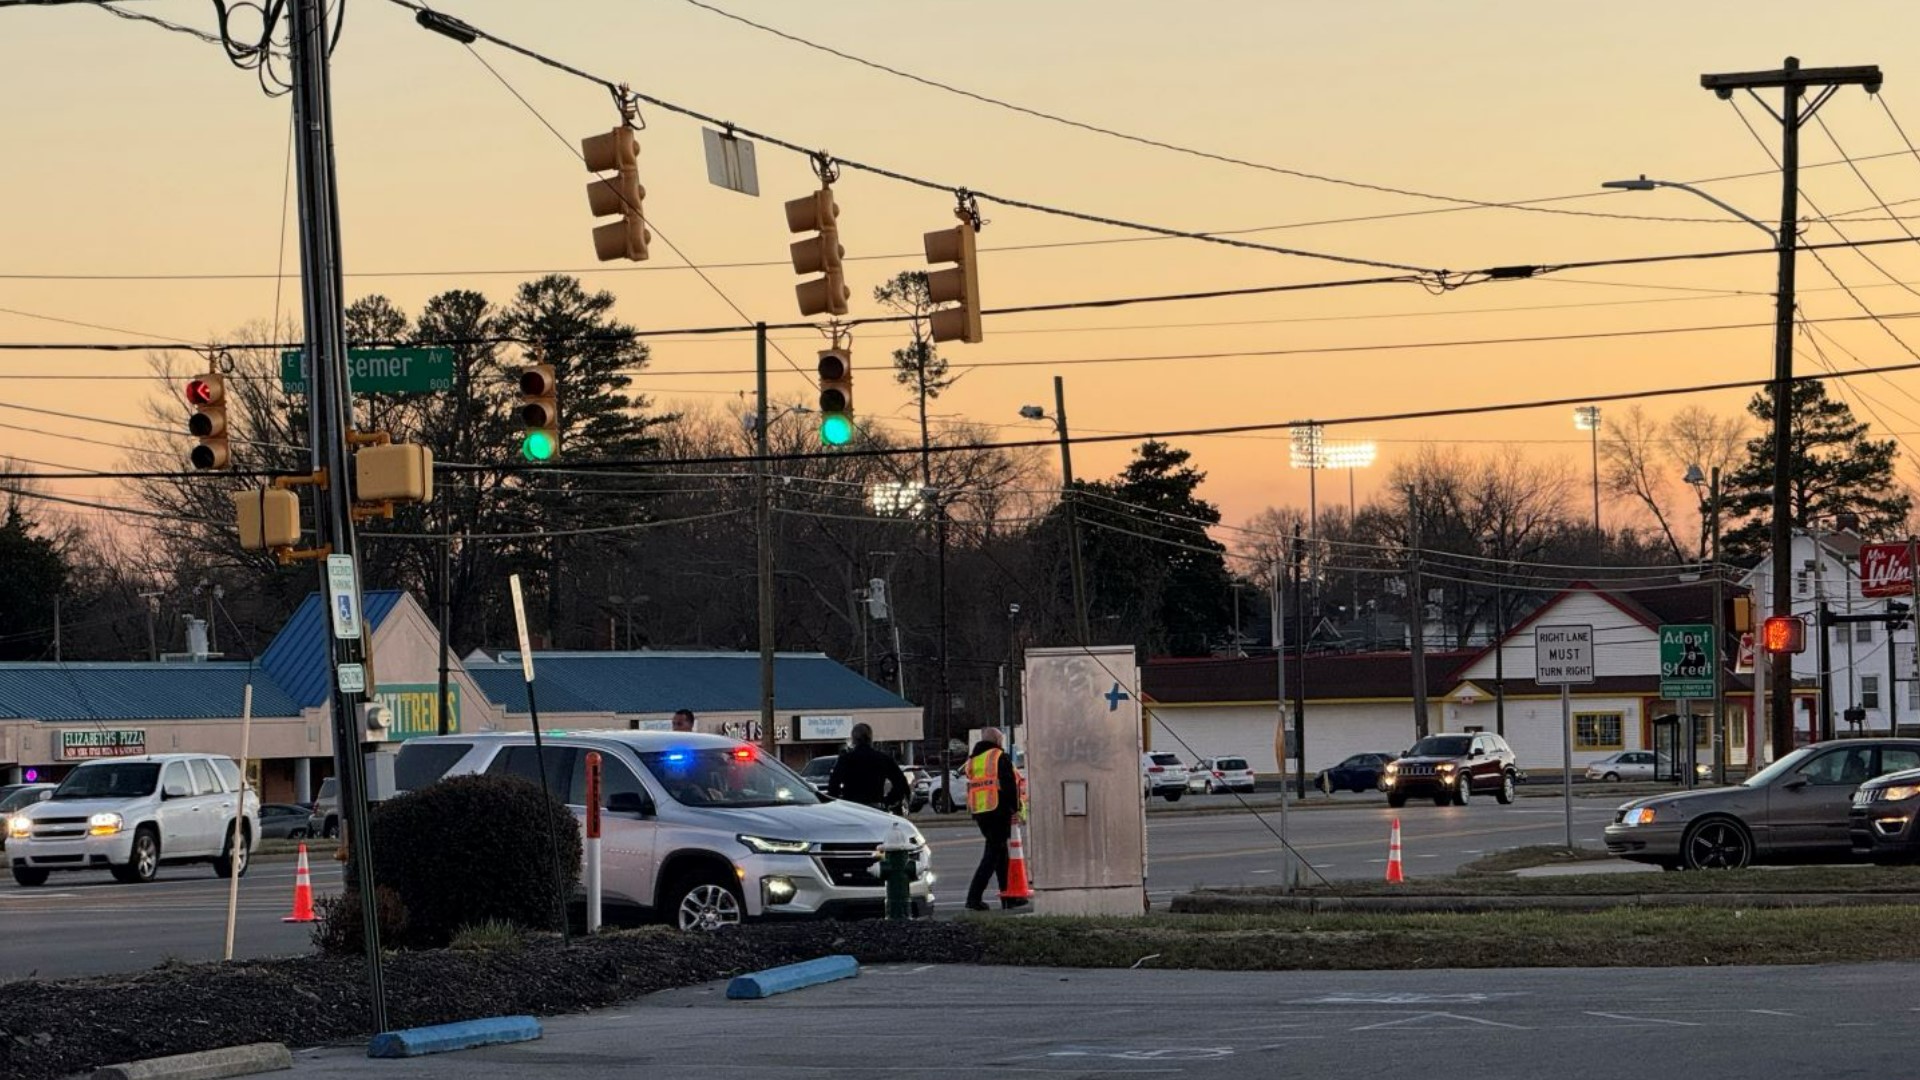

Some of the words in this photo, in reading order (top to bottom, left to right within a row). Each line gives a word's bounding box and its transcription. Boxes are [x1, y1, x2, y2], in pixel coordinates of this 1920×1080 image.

[287, 354, 295, 367] E
[428, 352, 443, 364] Av
[285, 382, 304, 392] 900
[430, 379, 449, 389] 800
[1540, 632, 1564, 643] RIGHT
[1566, 632, 1589, 642] LANE
[1663, 630, 1709, 648] Adopt
[1549, 648, 1580, 661] MUST
[1540, 667, 1562, 677] TURN
[1565, 666, 1591, 676] RIGHT
[1663, 661, 1713, 677] Street
[119, 731, 145, 745] PIZZA
